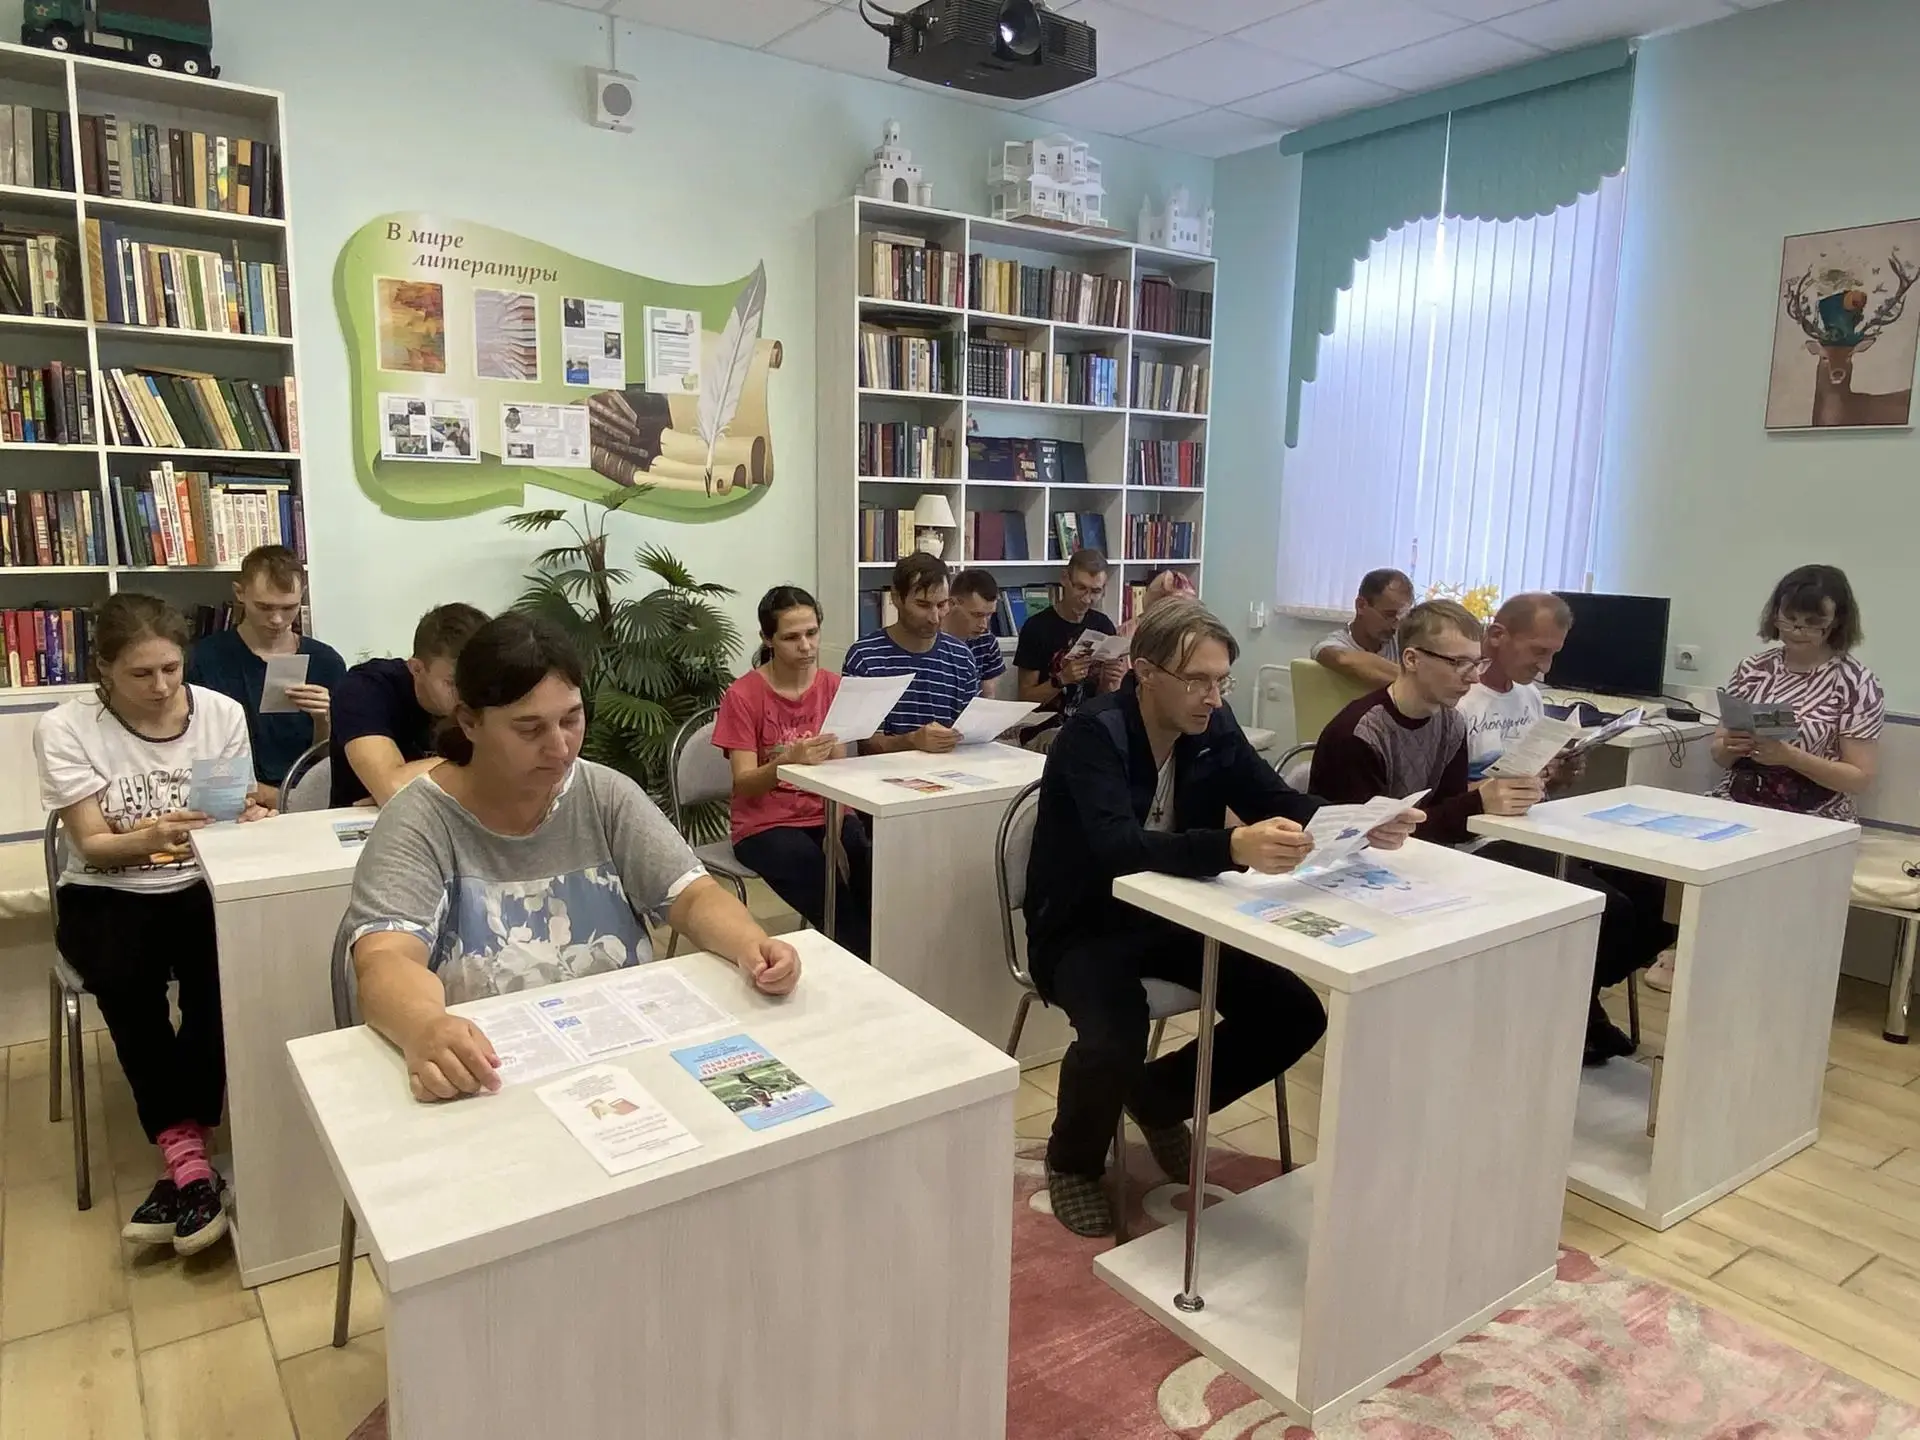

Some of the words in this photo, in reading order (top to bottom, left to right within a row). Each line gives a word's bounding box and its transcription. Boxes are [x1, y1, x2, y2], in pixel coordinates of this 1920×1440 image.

[386, 222, 401, 240] В
[408, 229, 464, 252] мире
[412, 253, 558, 285] литературы
